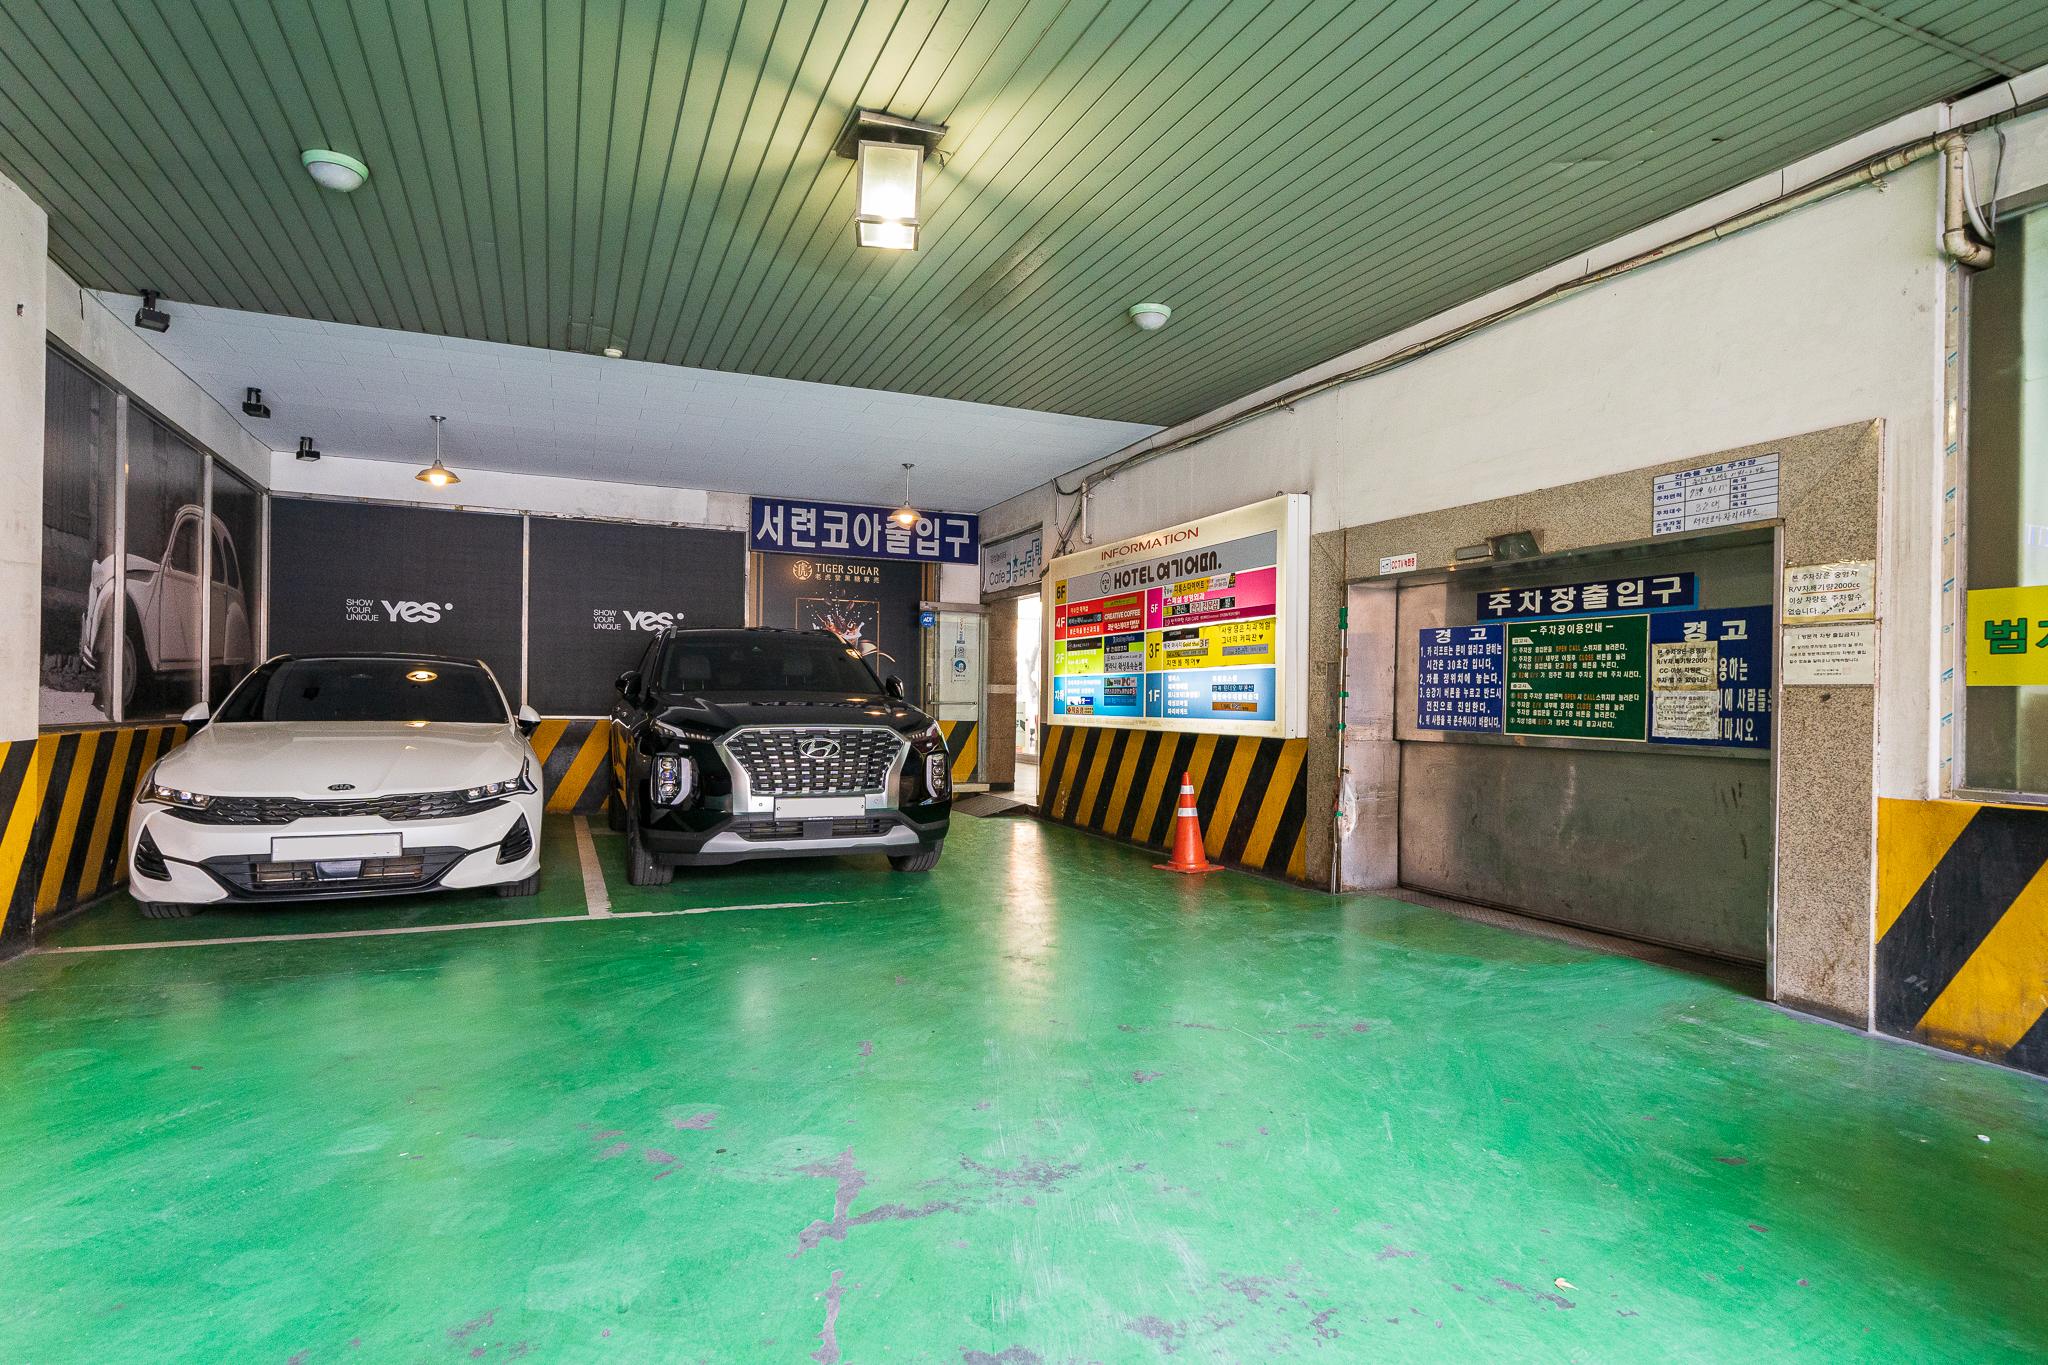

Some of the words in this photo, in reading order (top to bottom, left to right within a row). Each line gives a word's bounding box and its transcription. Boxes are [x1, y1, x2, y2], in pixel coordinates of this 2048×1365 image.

[1675, 471, 1700, 480] 건축물
[1728, 460, 1756, 469] 주차장
[1656, 508, 1682, 516] 주차대수
[756, 506, 970, 558] 서련코아출입구
[1101, 526, 1198, 560] INFORMATION
[816, 564, 844, 574] TIGER
[847, 566, 880, 576] SUGAR
[990, 570, 1005, 586] Cafe
[1114, 566, 1154, 589] HOTEL
[1802, 572, 1830, 581] 주차장은
[1056, 585, 1066, 599] 6F
[1488, 576, 1682, 616] 주차장출입구
[1150, 604, 1158, 614] 5F
[1788, 608, 1820, 616] 없습니다.
[1056, 617, 1066, 628] 4F
[1540, 622, 1602, 636] 주차장이용안내
[1200, 638, 1208, 648] 3F
[1149, 643, 1160, 658] 3F
[1421, 647, 1426, 658] 1.
[1456, 645, 1466, 656] 문이
[1468, 644, 1484, 656] 열리고
[1486, 644, 1502, 654] 닫히는
[1535, 646, 1552, 654] 출입문을
[1056, 653, 1064, 664] 2F
[1427, 660, 1444, 670] 시간은
[1448, 659, 1468, 670] 30초간
[1472, 658, 1494, 670] 입니다.
[1420, 674, 1426, 685] 2.
[1426, 673, 1438, 684] 차를
[1444, 672, 1470, 684] 정위치에
[1476, 672, 1502, 684] 놓는다.
[1148, 690, 1160, 702] 1F
[1420, 688, 1425, 698] 3.
[1426, 688, 1442, 698] 승강기
[1444, 688, 1460, 698] 버튼을
[1464, 688, 1480, 698] 누르고
[1484, 688, 1502, 699] 반드시
[1426, 701, 1452, 712] 전진으로
[1458, 702, 1490, 713] 진입한다.
[1419, 714, 1424, 725] 4.
[1432, 715, 1444, 726] 사항을
[1454, 716, 1476, 727] 준수하시기
[1479, 717, 1500, 728] 바랍니다.
[1718, 718, 1758, 741] 마시오.
